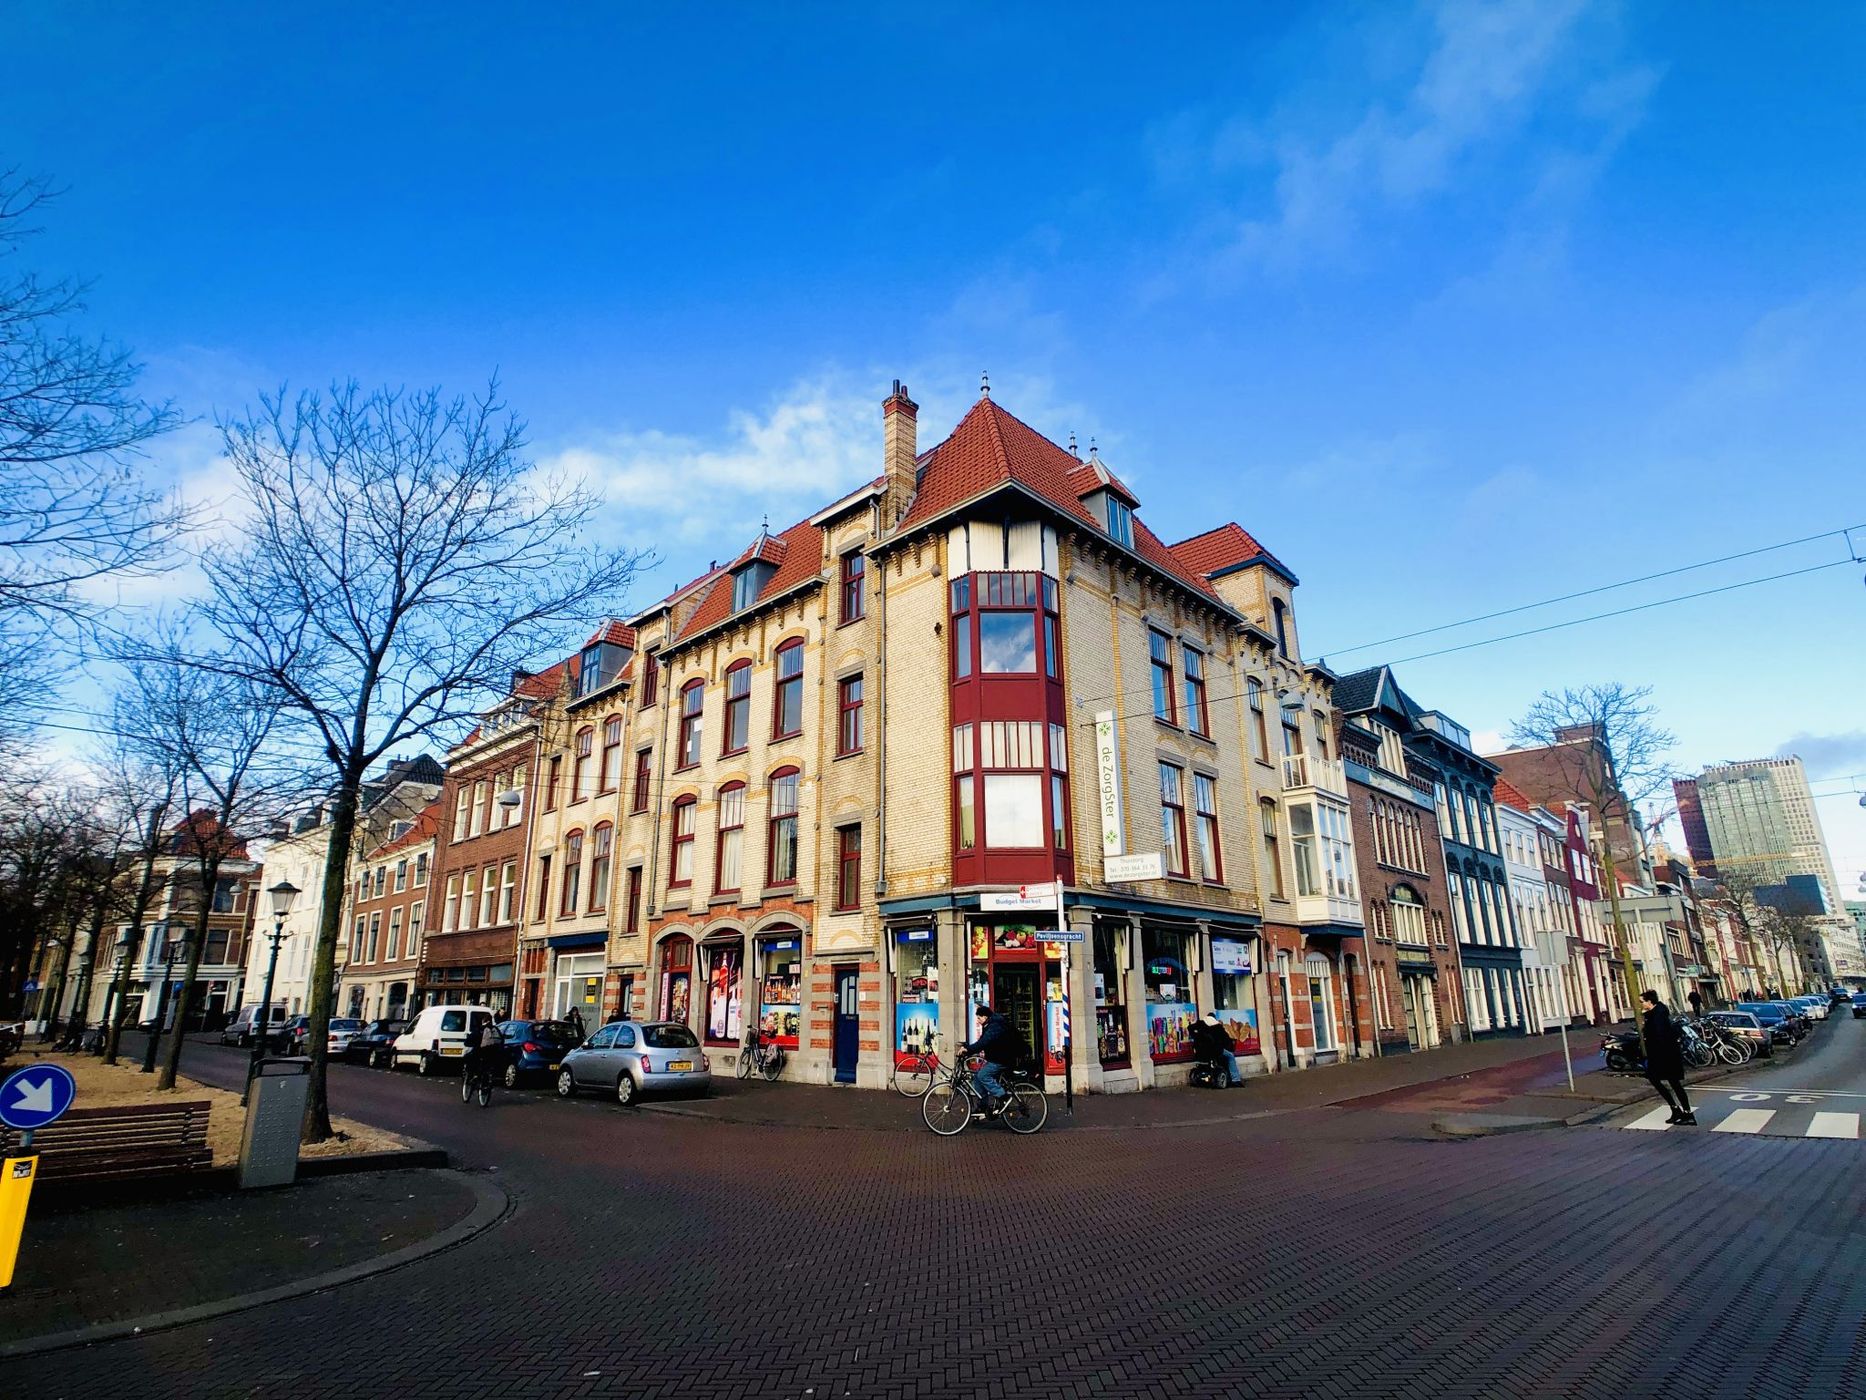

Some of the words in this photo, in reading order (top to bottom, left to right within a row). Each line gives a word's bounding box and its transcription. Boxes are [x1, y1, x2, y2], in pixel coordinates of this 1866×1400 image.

[1101, 746, 1113, 763] de
[1101, 765, 1116, 818] ZorgSter
[995, 898, 1018, 906] Budget
[1036, 933, 1082, 941] Paviljoensgracht
